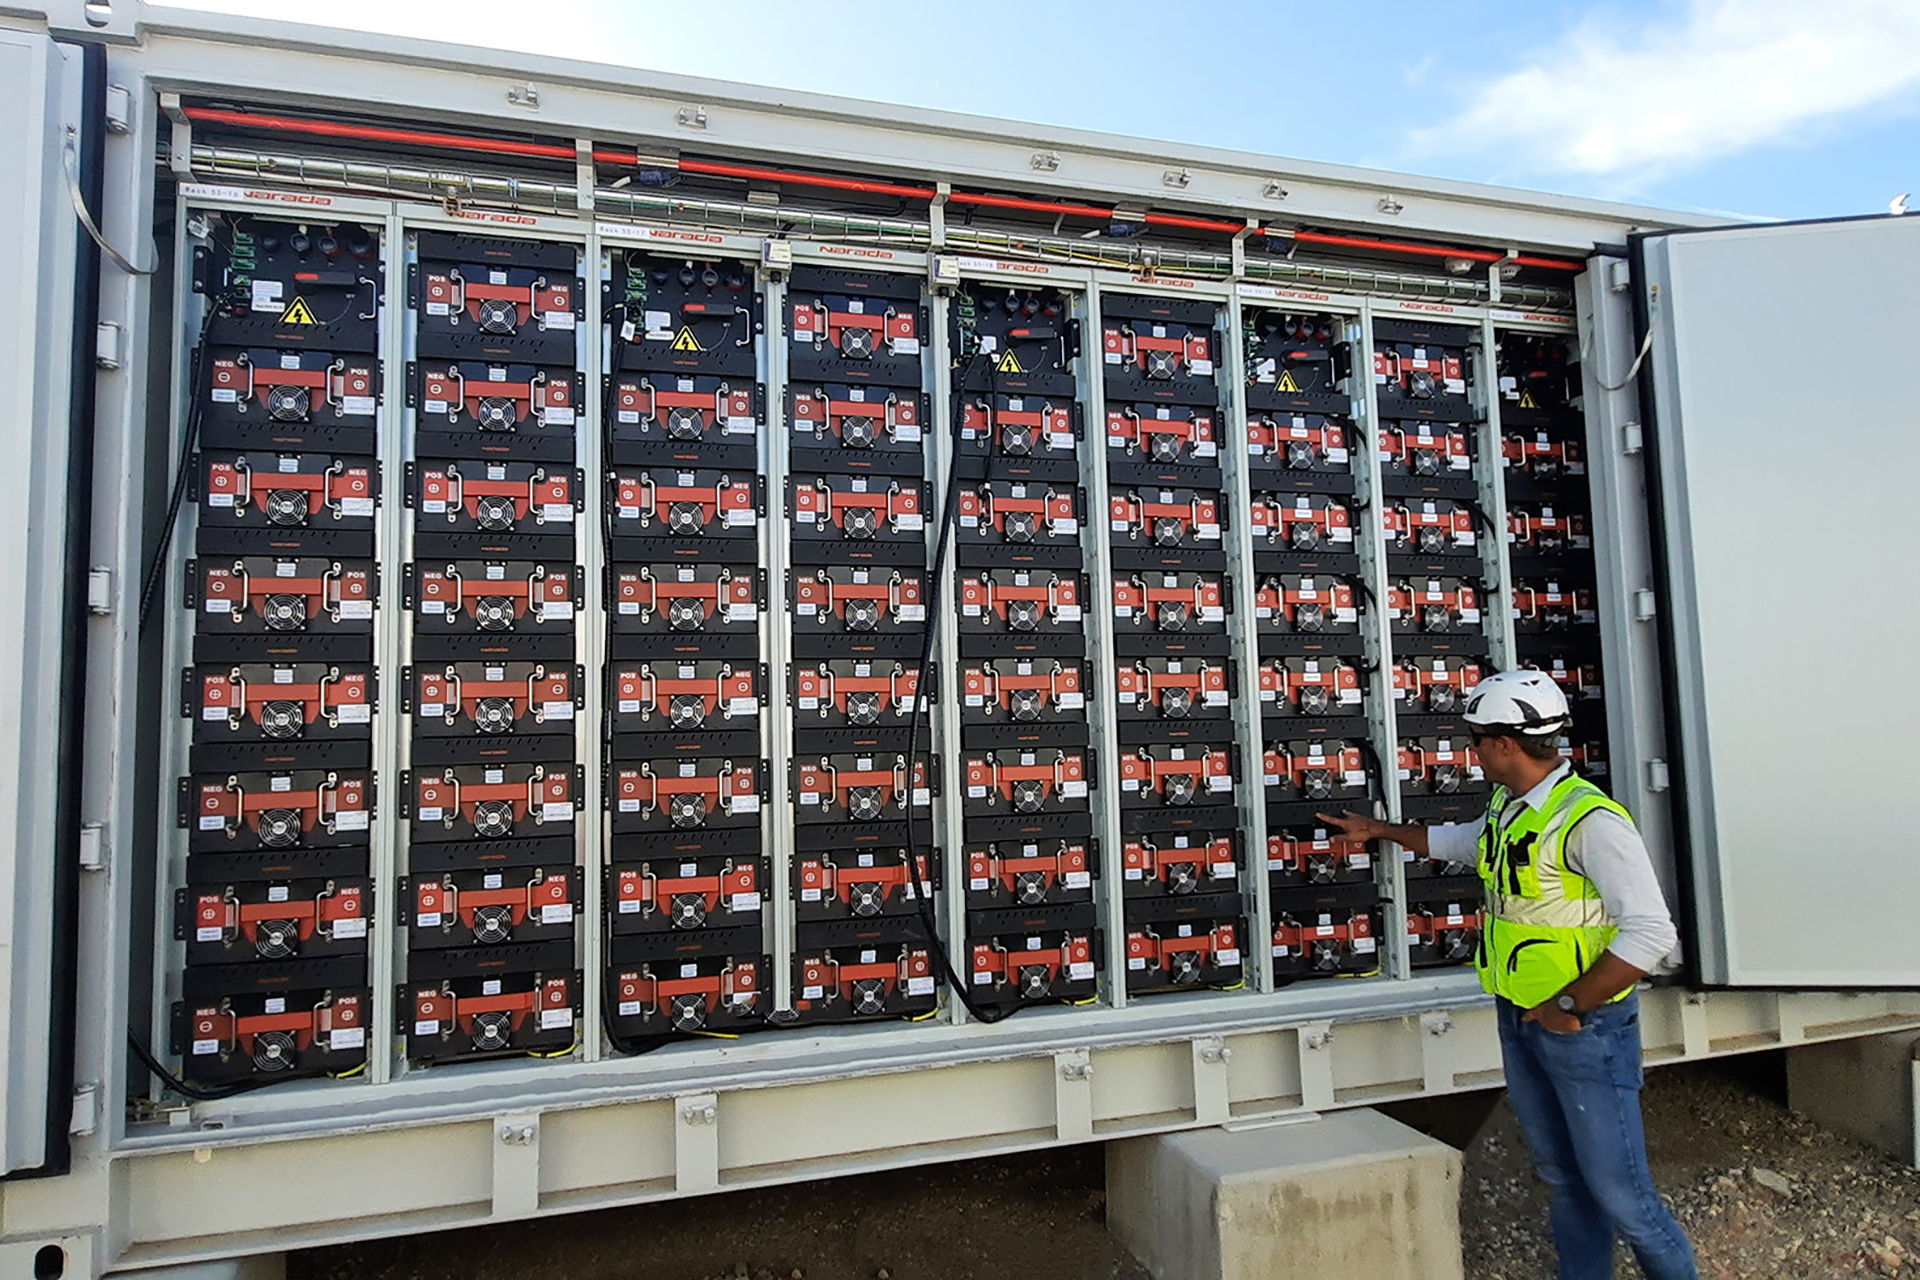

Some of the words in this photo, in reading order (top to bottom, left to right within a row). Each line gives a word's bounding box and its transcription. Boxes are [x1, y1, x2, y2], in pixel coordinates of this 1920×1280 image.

[184, 186, 207, 194] Rack
[819, 245, 893, 259] Narada
[996, 262, 1049, 274] arada
[428, 274, 446, 283] POS
[1131, 275, 1195, 288] Narada
[551, 285, 569, 293] NEG
[794, 304, 810, 312] POS
[1398, 301, 1454, 313] Narada
[214, 360, 235, 368] NEG
[350, 367, 369, 376] POS
[426, 372, 446, 381] NEG
[550, 379, 568, 388] POS
[619, 384, 637, 392] NEG
[732, 390, 749, 398] POS
[795, 393, 812, 401] NEG
[899, 400, 914, 408] POS
[211, 463, 231, 472] POS
[348, 468, 368, 477] NEG
[424, 471, 443, 480] POS
[549, 476, 567, 484] NEG
[619, 478, 636, 486] POS
[732, 482, 750, 490] NEG
[796, 484, 813, 492] POS
[901, 488, 917, 496] NEG
[209, 569, 229, 577] NEG
[347, 571, 366, 579] POS
[423, 572, 443, 580] NEG
[549, 573, 567, 581] POS
[619, 574, 637, 582] NEG
[734, 576, 751, 584] POS
[797, 576, 814, 584] NEG
[903, 578, 919, 586] POS
[344, 674, 364, 682] NEG
[422, 674, 441, 682] POS
[619, 672, 637, 680] POS
[734, 670, 752, 678] NEG
[798, 670, 815, 678] POS
[205, 676, 226, 684] POS
[736, 767, 753, 775] POS
[421, 777, 440, 785] NEG
[548, 773, 566, 781] POS
[342, 780, 362, 789] POS
[202, 785, 223, 793] NEG
[736, 864, 754, 872] NEG
[801, 861, 818, 869] POS
[547, 875, 566, 883] NEG
[619, 871, 637, 879] POS
[419, 882, 438, 891] POS
[340, 887, 360, 895] NEG
[199, 895, 219, 904] POS
[912, 950, 927, 958] POS
[804, 958, 820, 966] NEG
[738, 963, 755, 971] POS
[620, 972, 638, 981] NEG
[547, 979, 565, 987] POS
[417, 989, 437, 999] NEG
[338, 996, 358, 1005] POS
[196, 1007, 217, 1016] NEG
